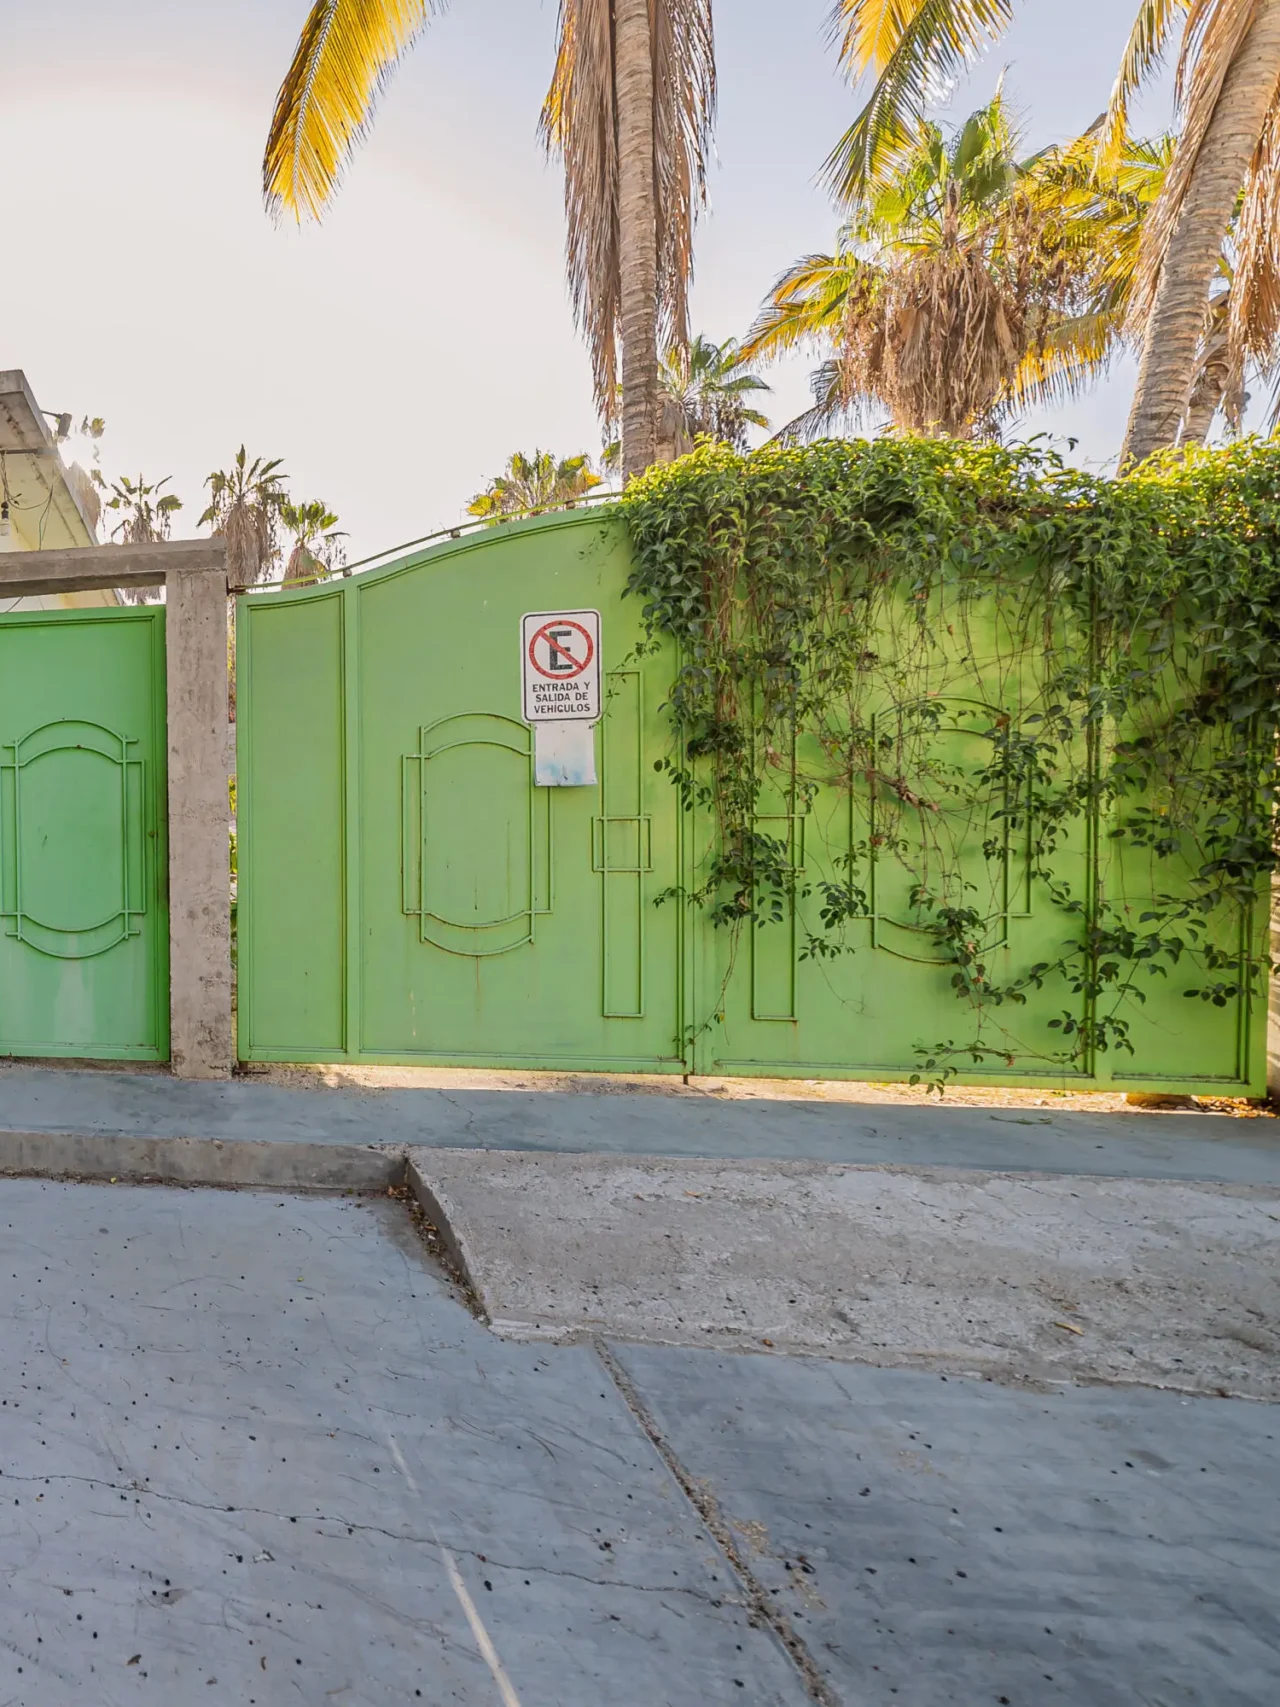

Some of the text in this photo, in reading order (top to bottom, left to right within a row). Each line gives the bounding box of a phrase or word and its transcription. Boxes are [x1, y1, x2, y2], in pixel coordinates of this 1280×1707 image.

[532, 681, 590, 692] ENTRADA Y
[535, 692, 588, 702] SALIDA DE
